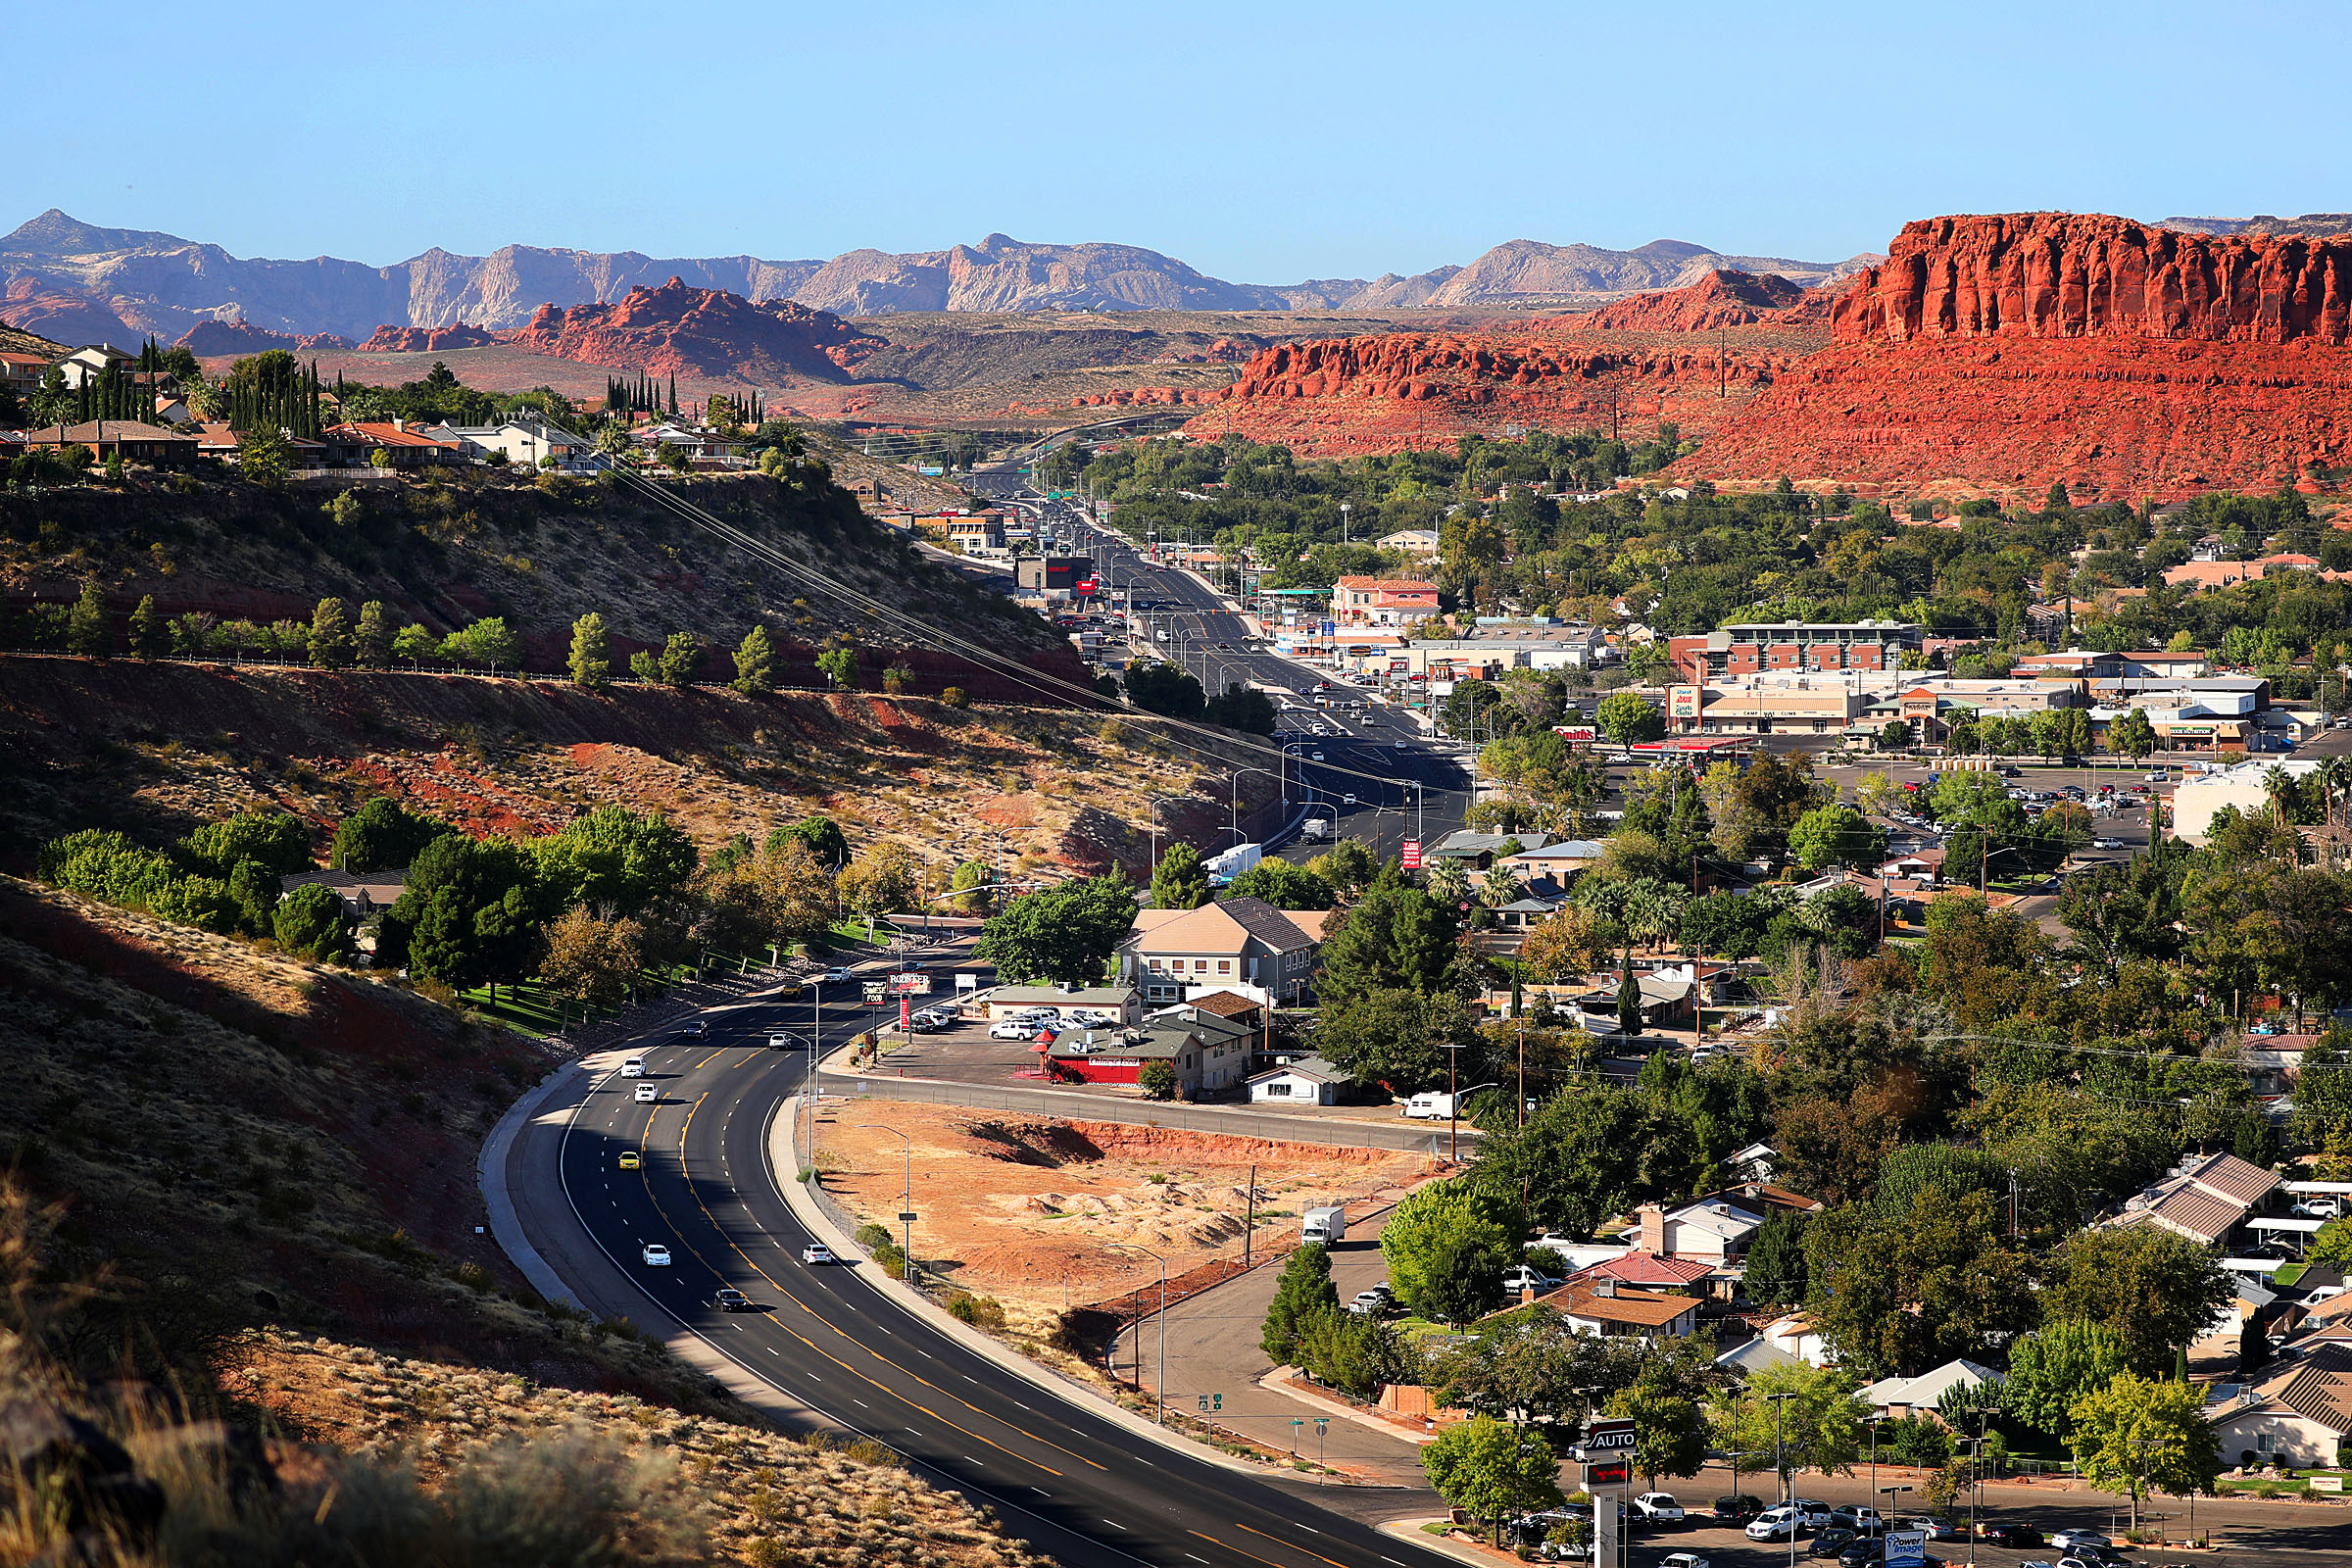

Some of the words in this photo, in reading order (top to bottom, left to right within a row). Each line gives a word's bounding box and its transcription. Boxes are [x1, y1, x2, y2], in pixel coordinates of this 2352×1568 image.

[1555, 728, 1594, 740] Smith's
[890, 974, 930, 984] ROOSTER
[1595, 1434, 1635, 1447] AUTO
[1892, 1536, 1921, 1547] Power
[1894, 1544, 1923, 1553] Image
